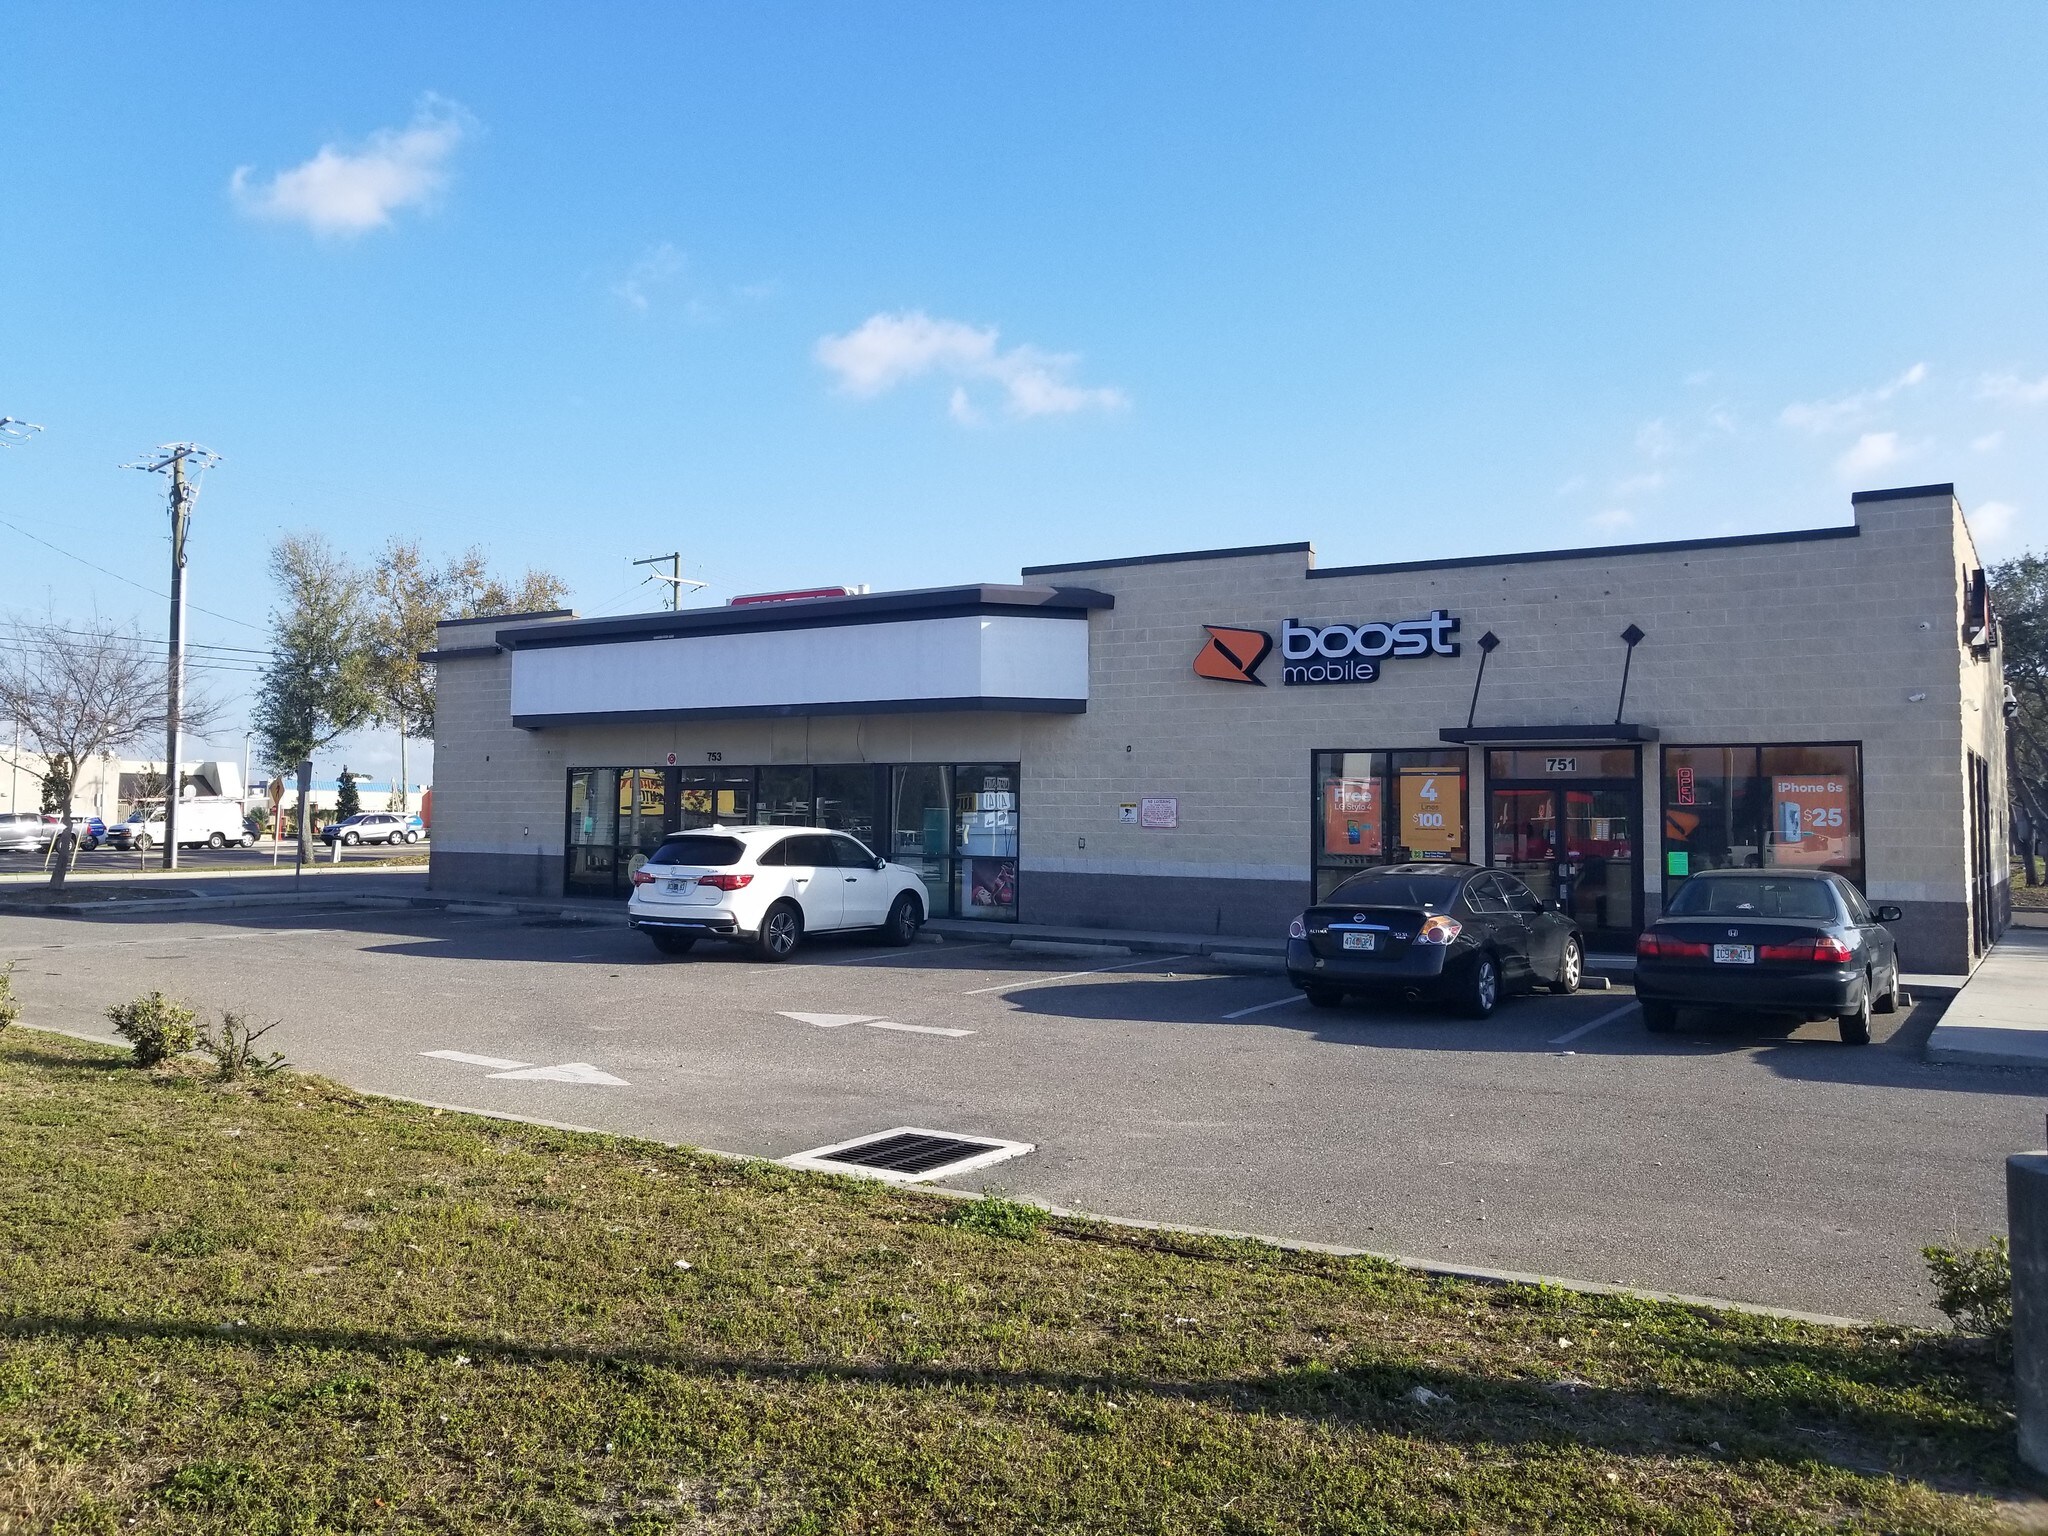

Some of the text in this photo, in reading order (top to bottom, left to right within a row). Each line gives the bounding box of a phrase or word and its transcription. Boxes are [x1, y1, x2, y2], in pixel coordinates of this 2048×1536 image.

[1282, 611, 1453, 660] boost
[1283, 661, 1374, 683] mobile
[707, 752, 722, 761] 753
[1547, 758, 1576, 771] 751
[1419, 778, 1438, 801] 4
[1680, 770, 1691, 802] OPEN
[1778, 782, 1843, 793] iPhone 6s
[1334, 788, 1372, 802] Free
[1347, 803, 1366, 812] Stylo
[1413, 813, 1443, 827] $100
[1803, 808, 1843, 827] $25
